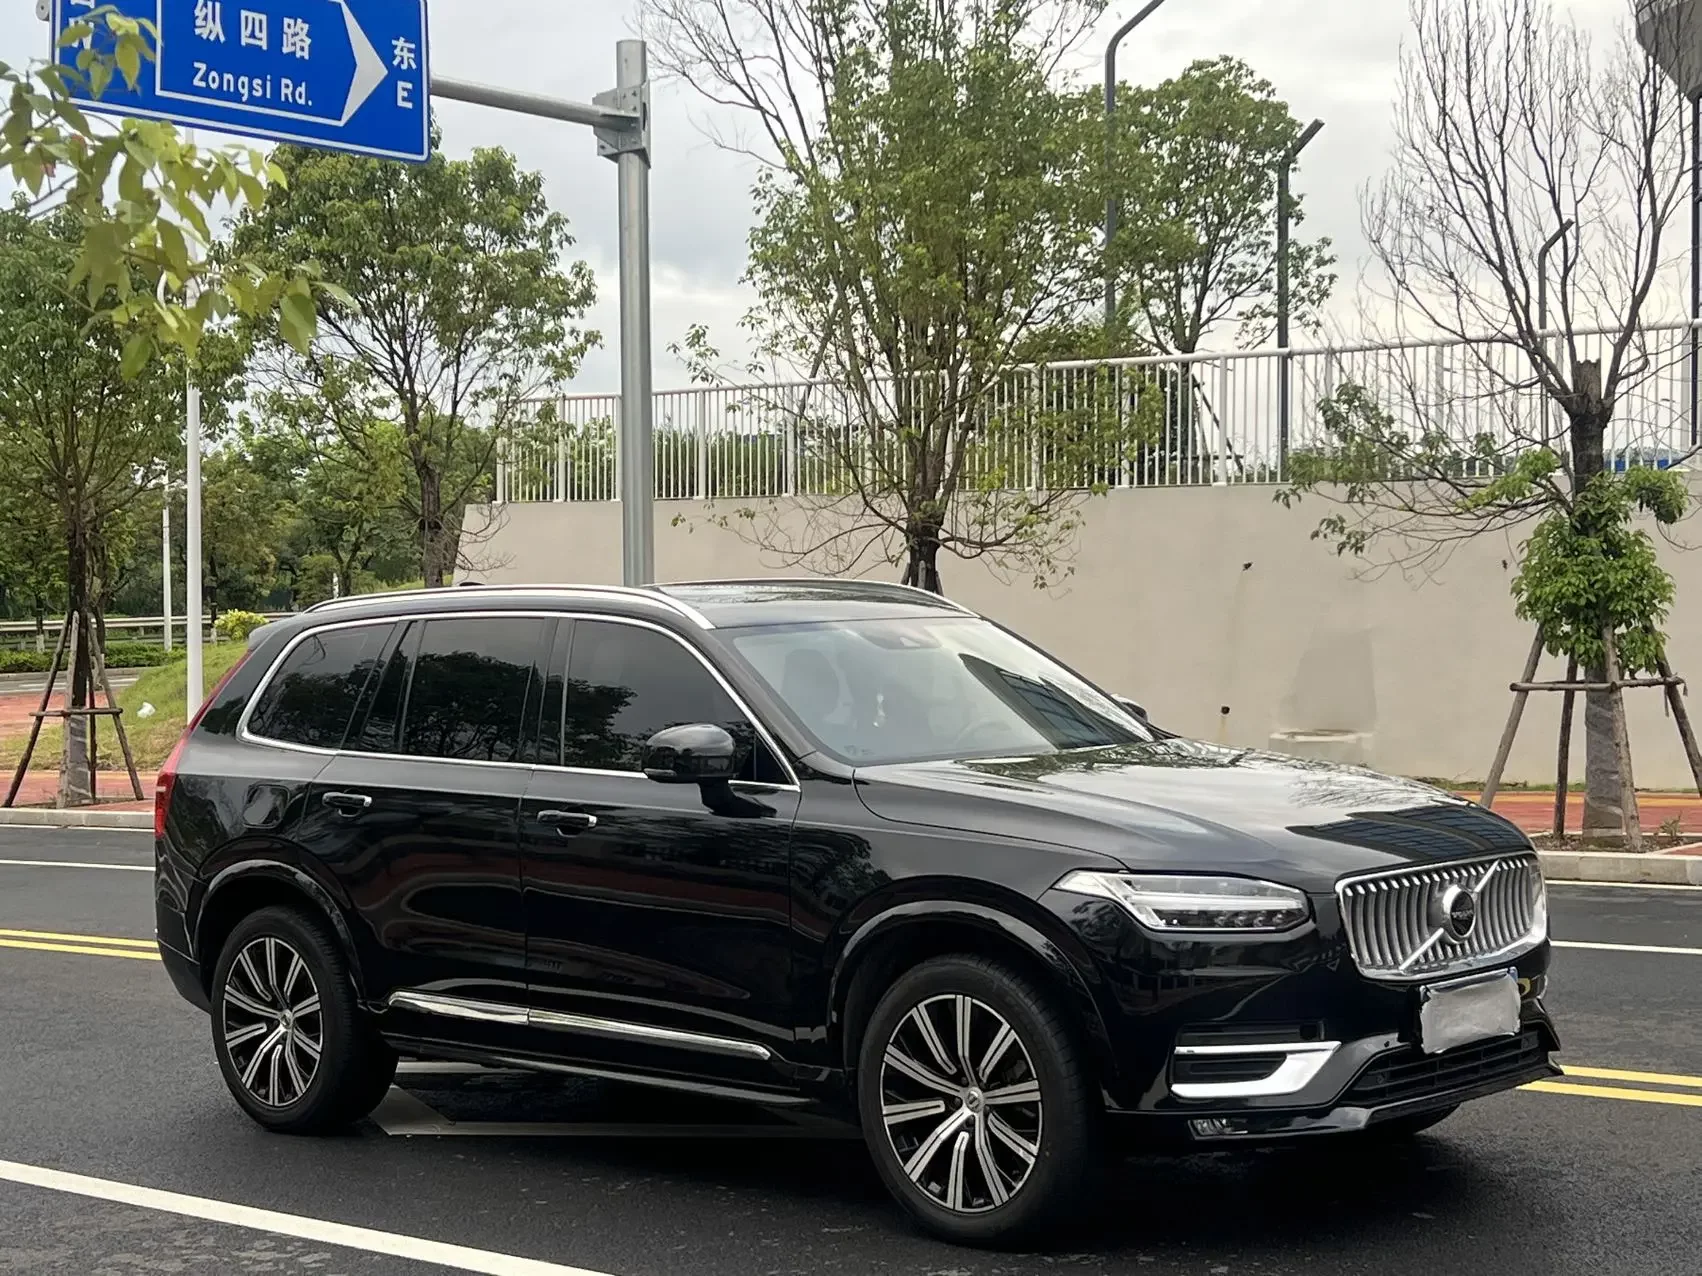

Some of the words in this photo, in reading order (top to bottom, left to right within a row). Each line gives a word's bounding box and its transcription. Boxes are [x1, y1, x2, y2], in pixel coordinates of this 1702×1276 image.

[194, 0, 312, 60] 纵四路
[391, 36, 417, 70] 东
[193, 61, 271, 102] Zongsi
[281, 77, 312, 106] Rd.
[397, 80, 413, 109] E
